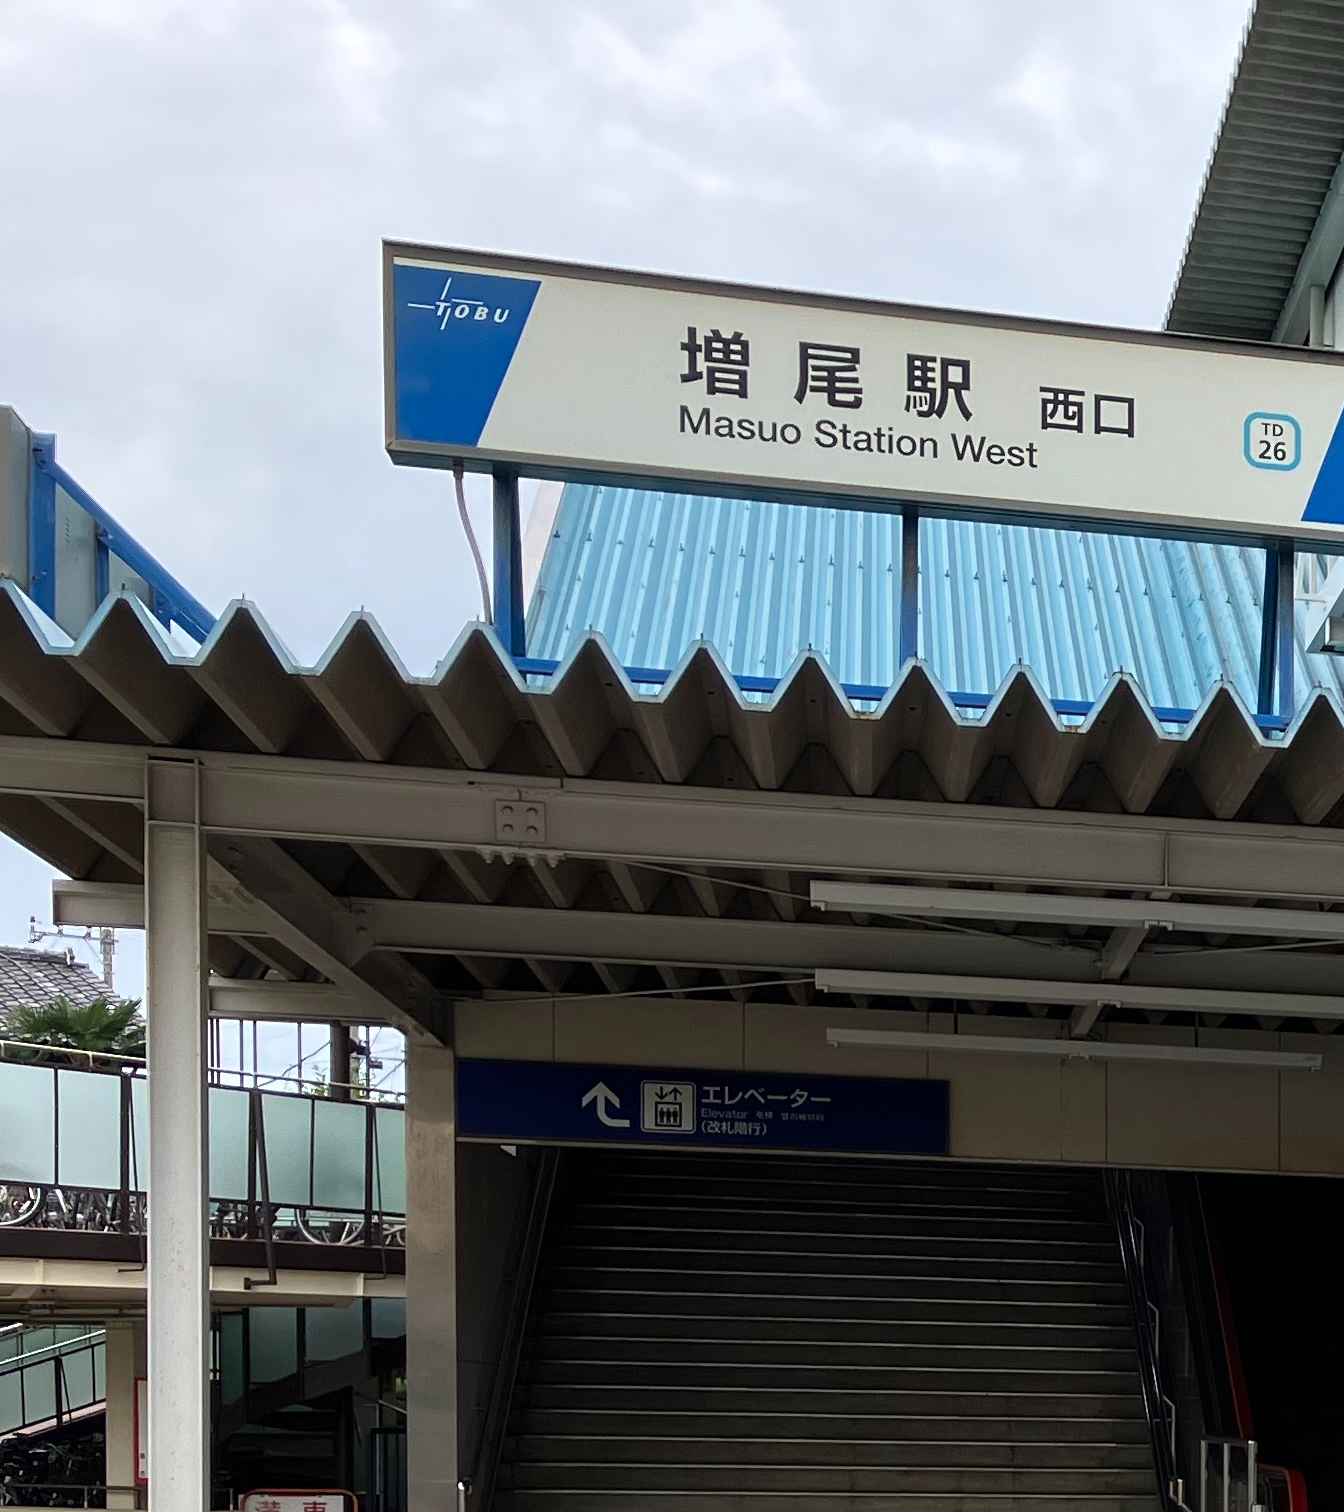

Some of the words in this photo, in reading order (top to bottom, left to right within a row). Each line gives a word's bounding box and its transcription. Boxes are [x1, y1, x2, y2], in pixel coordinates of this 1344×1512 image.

[435, 299, 510, 323] TOBU
[679, 326, 973, 423] 増尾駅
[1039, 385, 1136, 438] 西口
[678, 404, 801, 445] Masuo
[813, 419, 939, 459] Station
[950, 432, 1039, 468] West
[1260, 422, 1284, 437] TD
[1258, 440, 1287, 461] 26
[701, 1085, 832, 1108] エレベーター
